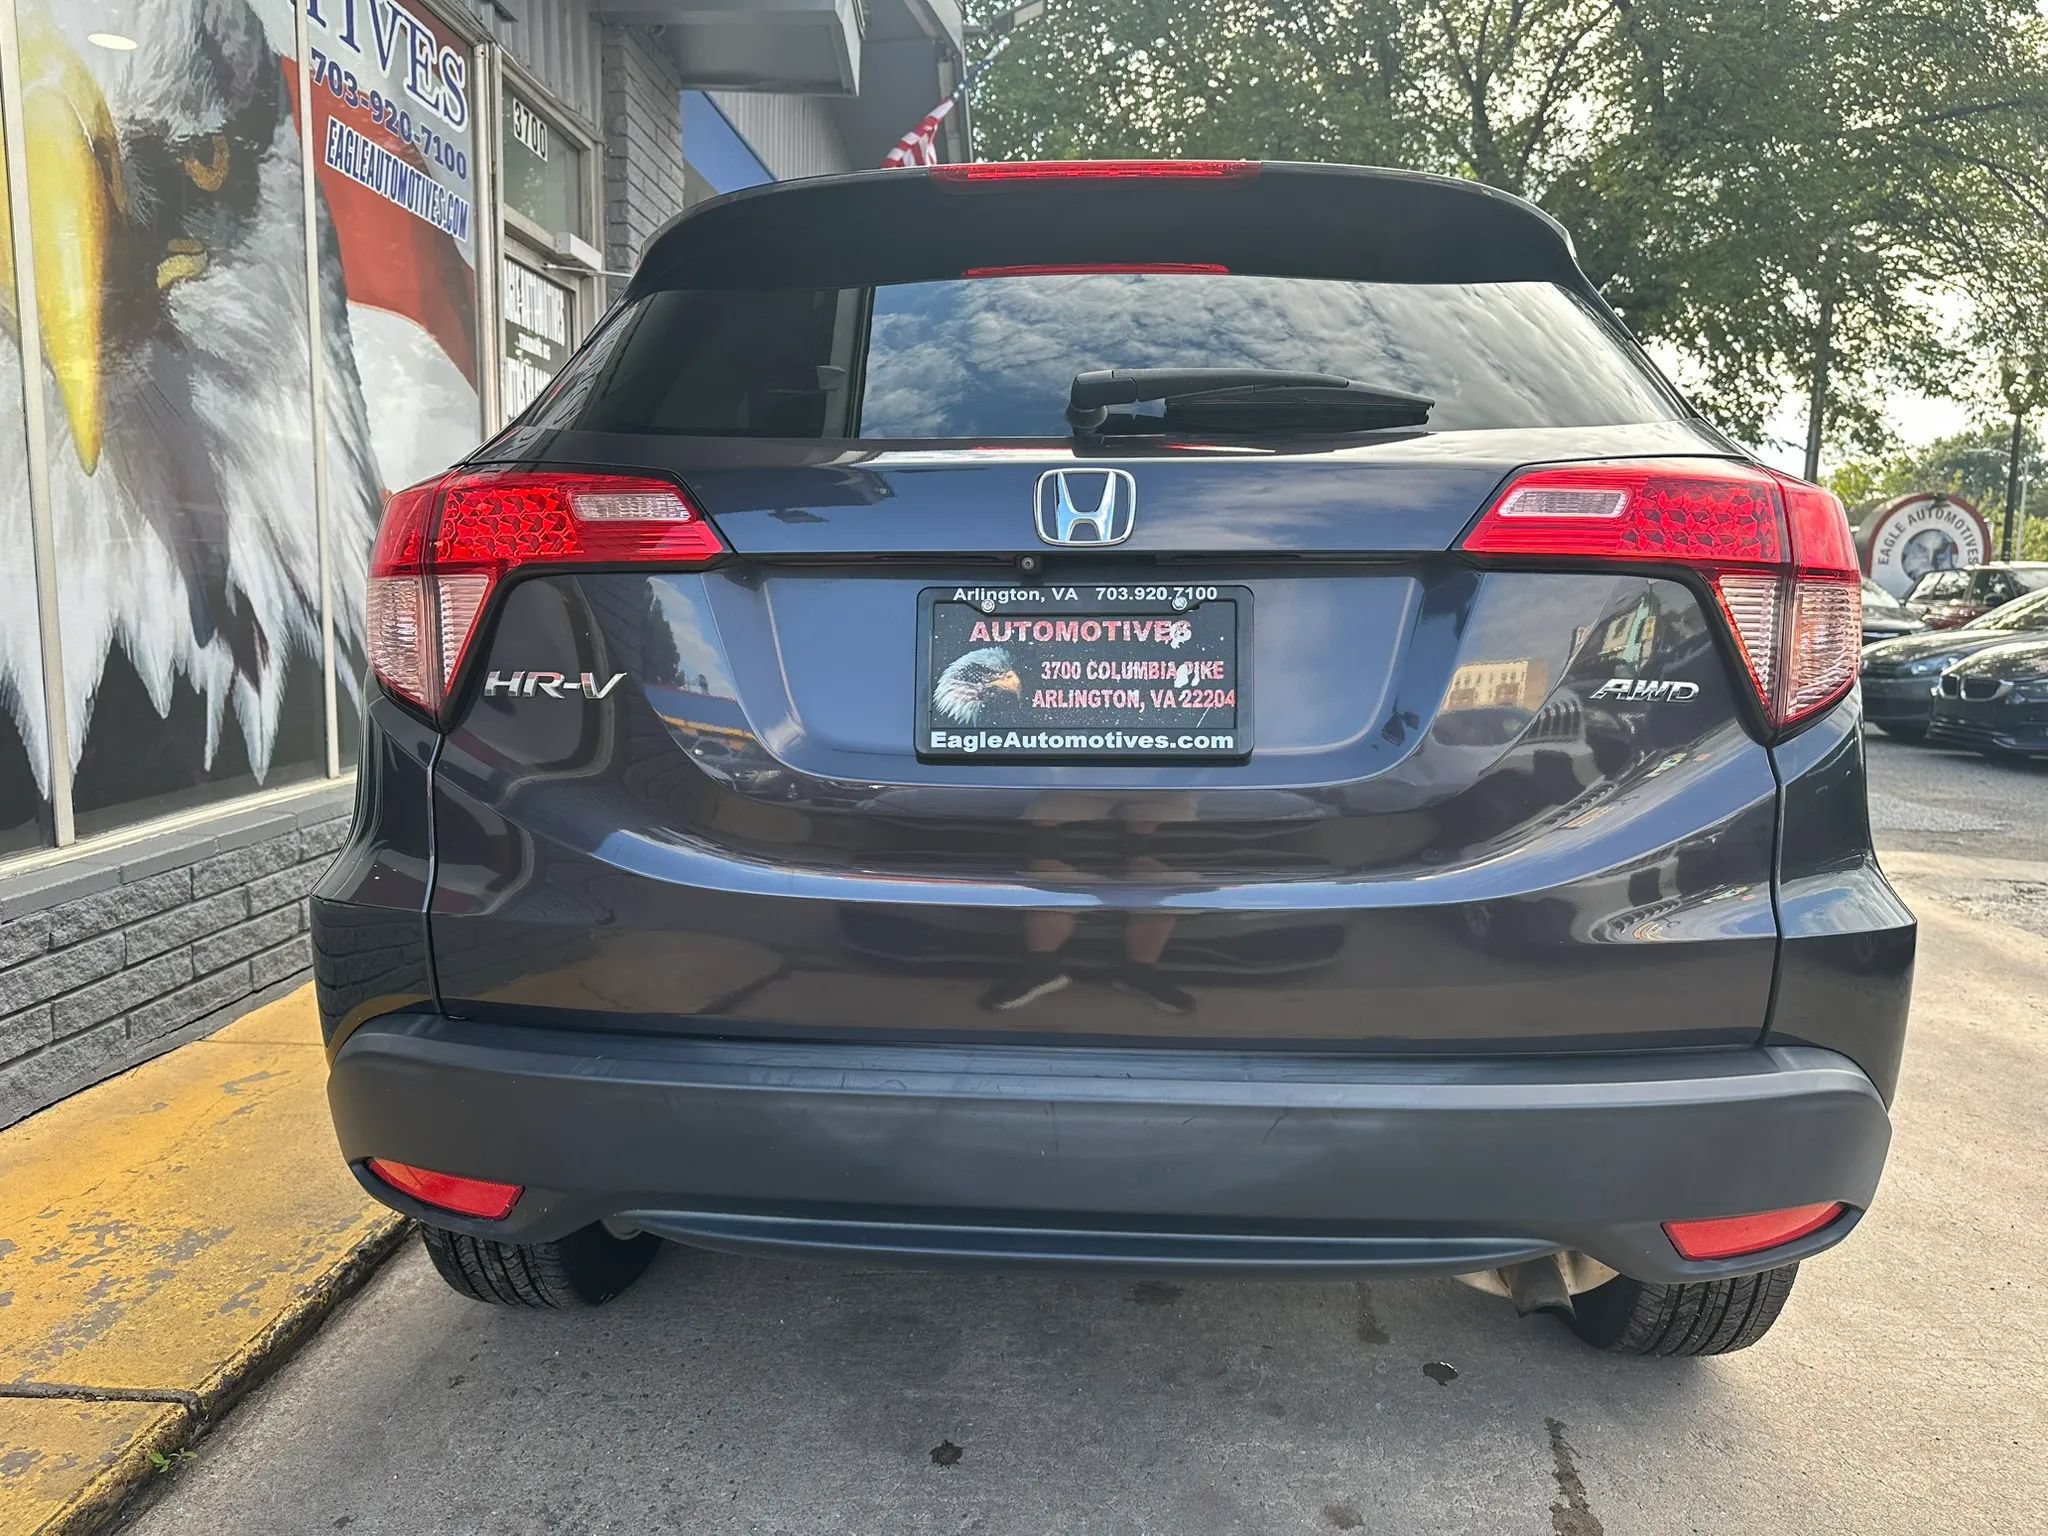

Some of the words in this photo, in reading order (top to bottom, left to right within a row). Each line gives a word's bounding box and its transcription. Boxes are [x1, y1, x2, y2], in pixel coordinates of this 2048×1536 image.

[310, 46, 468, 181] 703-920-7100
[514, 100, 547, 159] 3700
[326, 117, 470, 241] EAGLEAUTOMOTIVES.COM
[1877, 522, 1907, 565] EAGLE
[1907, 507, 1980, 565] AUTOMOTIVES
[953, 587, 1045, 603] Arlington,
[1052, 587, 1079, 601] VA
[1095, 586, 1218, 601] 703.920.7100
[968, 620, 1192, 643] AUTOMOTIVES
[1041, 660, 1081, 680] 3700
[1086, 660, 1178, 681] COLUMBIA
[484, 670, 628, 700] HR-V
[1590, 678, 1700, 702] AWD
[1032, 688, 1146, 713] ARLINGTON,
[1149, 688, 1176, 709] VA
[1181, 688, 1236, 709] 22204
[930, 731, 1234, 753] EagleAutomotives.com
